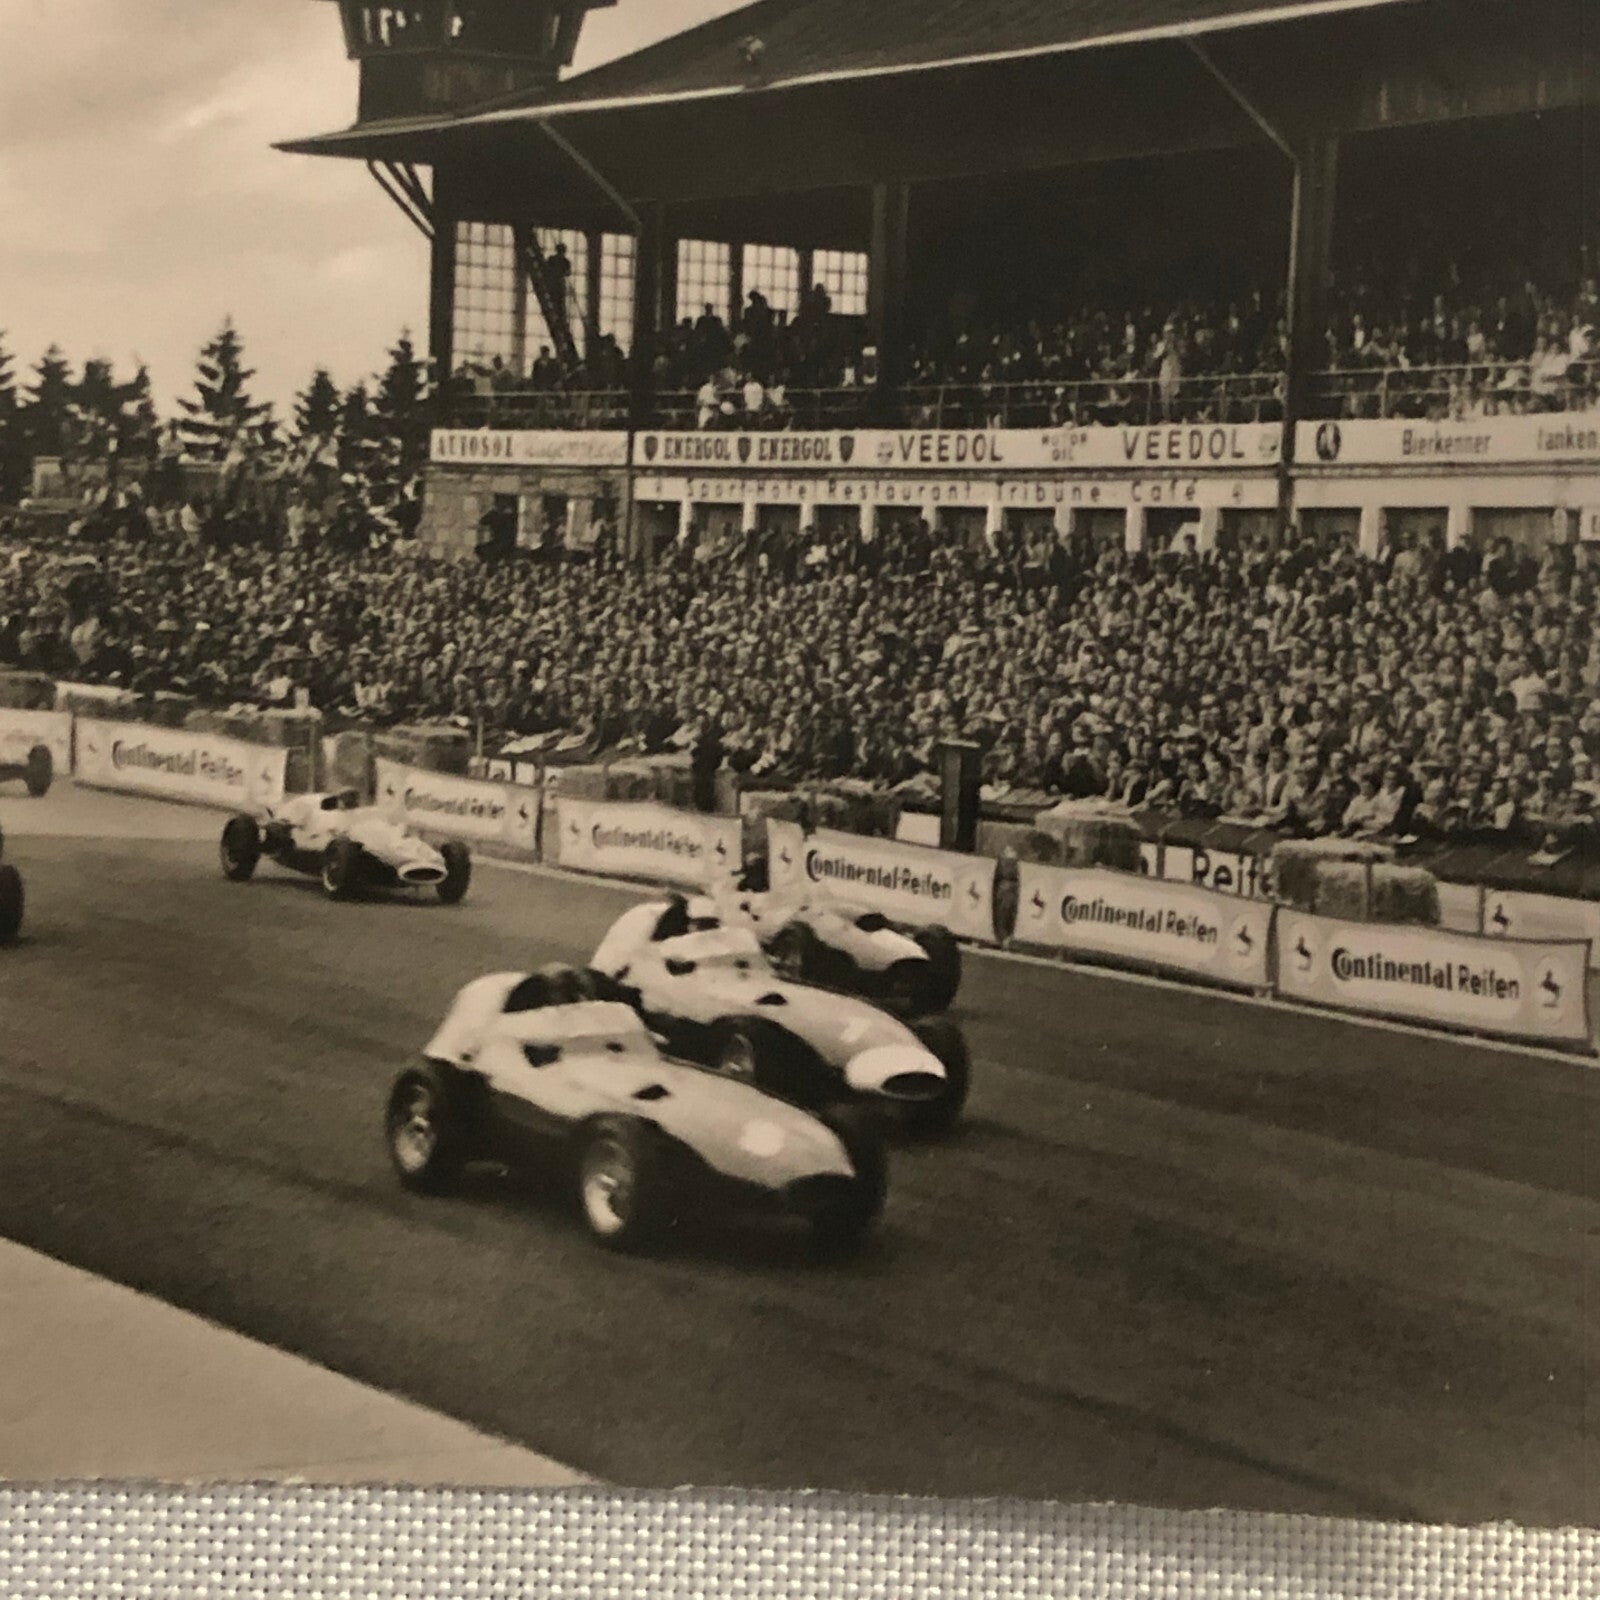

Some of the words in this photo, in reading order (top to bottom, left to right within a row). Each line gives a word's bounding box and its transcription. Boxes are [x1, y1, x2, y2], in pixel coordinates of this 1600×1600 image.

[664, 437, 732, 461] ENERGOL
[758, 437, 832, 462] ENERGOL
[900, 434, 1003, 462] VEEDOL
[1123, 428, 1245, 461] VEEDOL
[112, 740, 196, 776] Continental
[806, 849, 899, 889] Continental
[901, 867, 952, 899] Reifen
[1061, 895, 1163, 934] Continental
[1166, 910, 1218, 944] Reifen
[1331, 947, 1453, 991] Continental
[1458, 964, 1520, 999] Reifen
